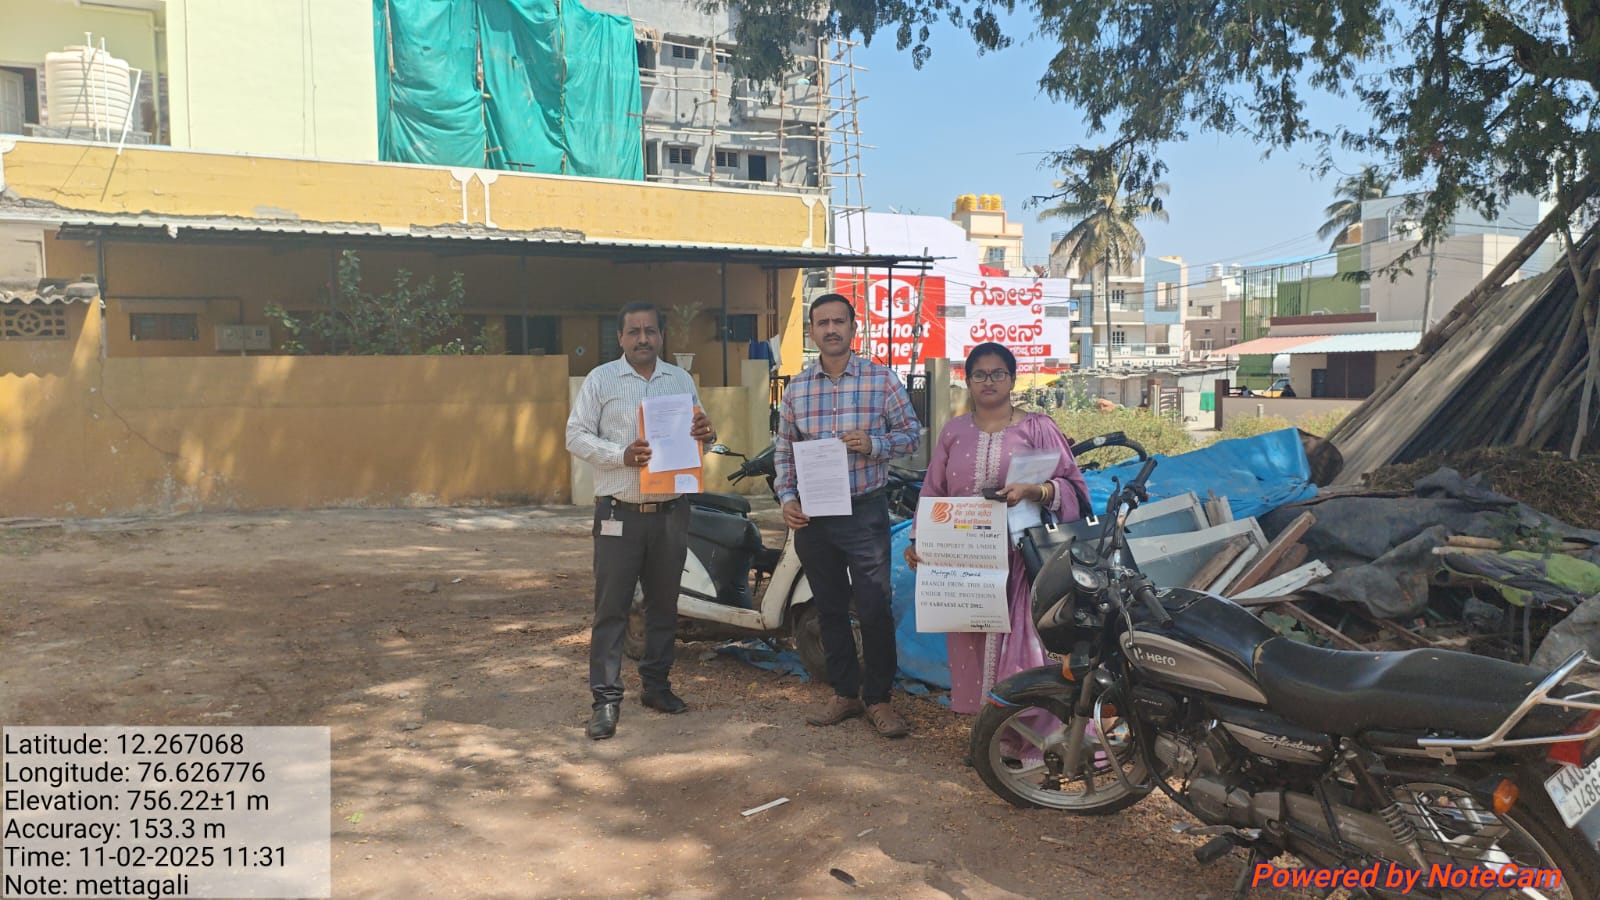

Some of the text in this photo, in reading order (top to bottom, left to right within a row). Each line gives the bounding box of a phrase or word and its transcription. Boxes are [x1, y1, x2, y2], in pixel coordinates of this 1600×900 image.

[970, 281, 1043, 314] ಗೋಲ್ಡ್
[970, 319, 1043, 343] ಲೋನ್
[1145, 652, 1176, 666] Hero
